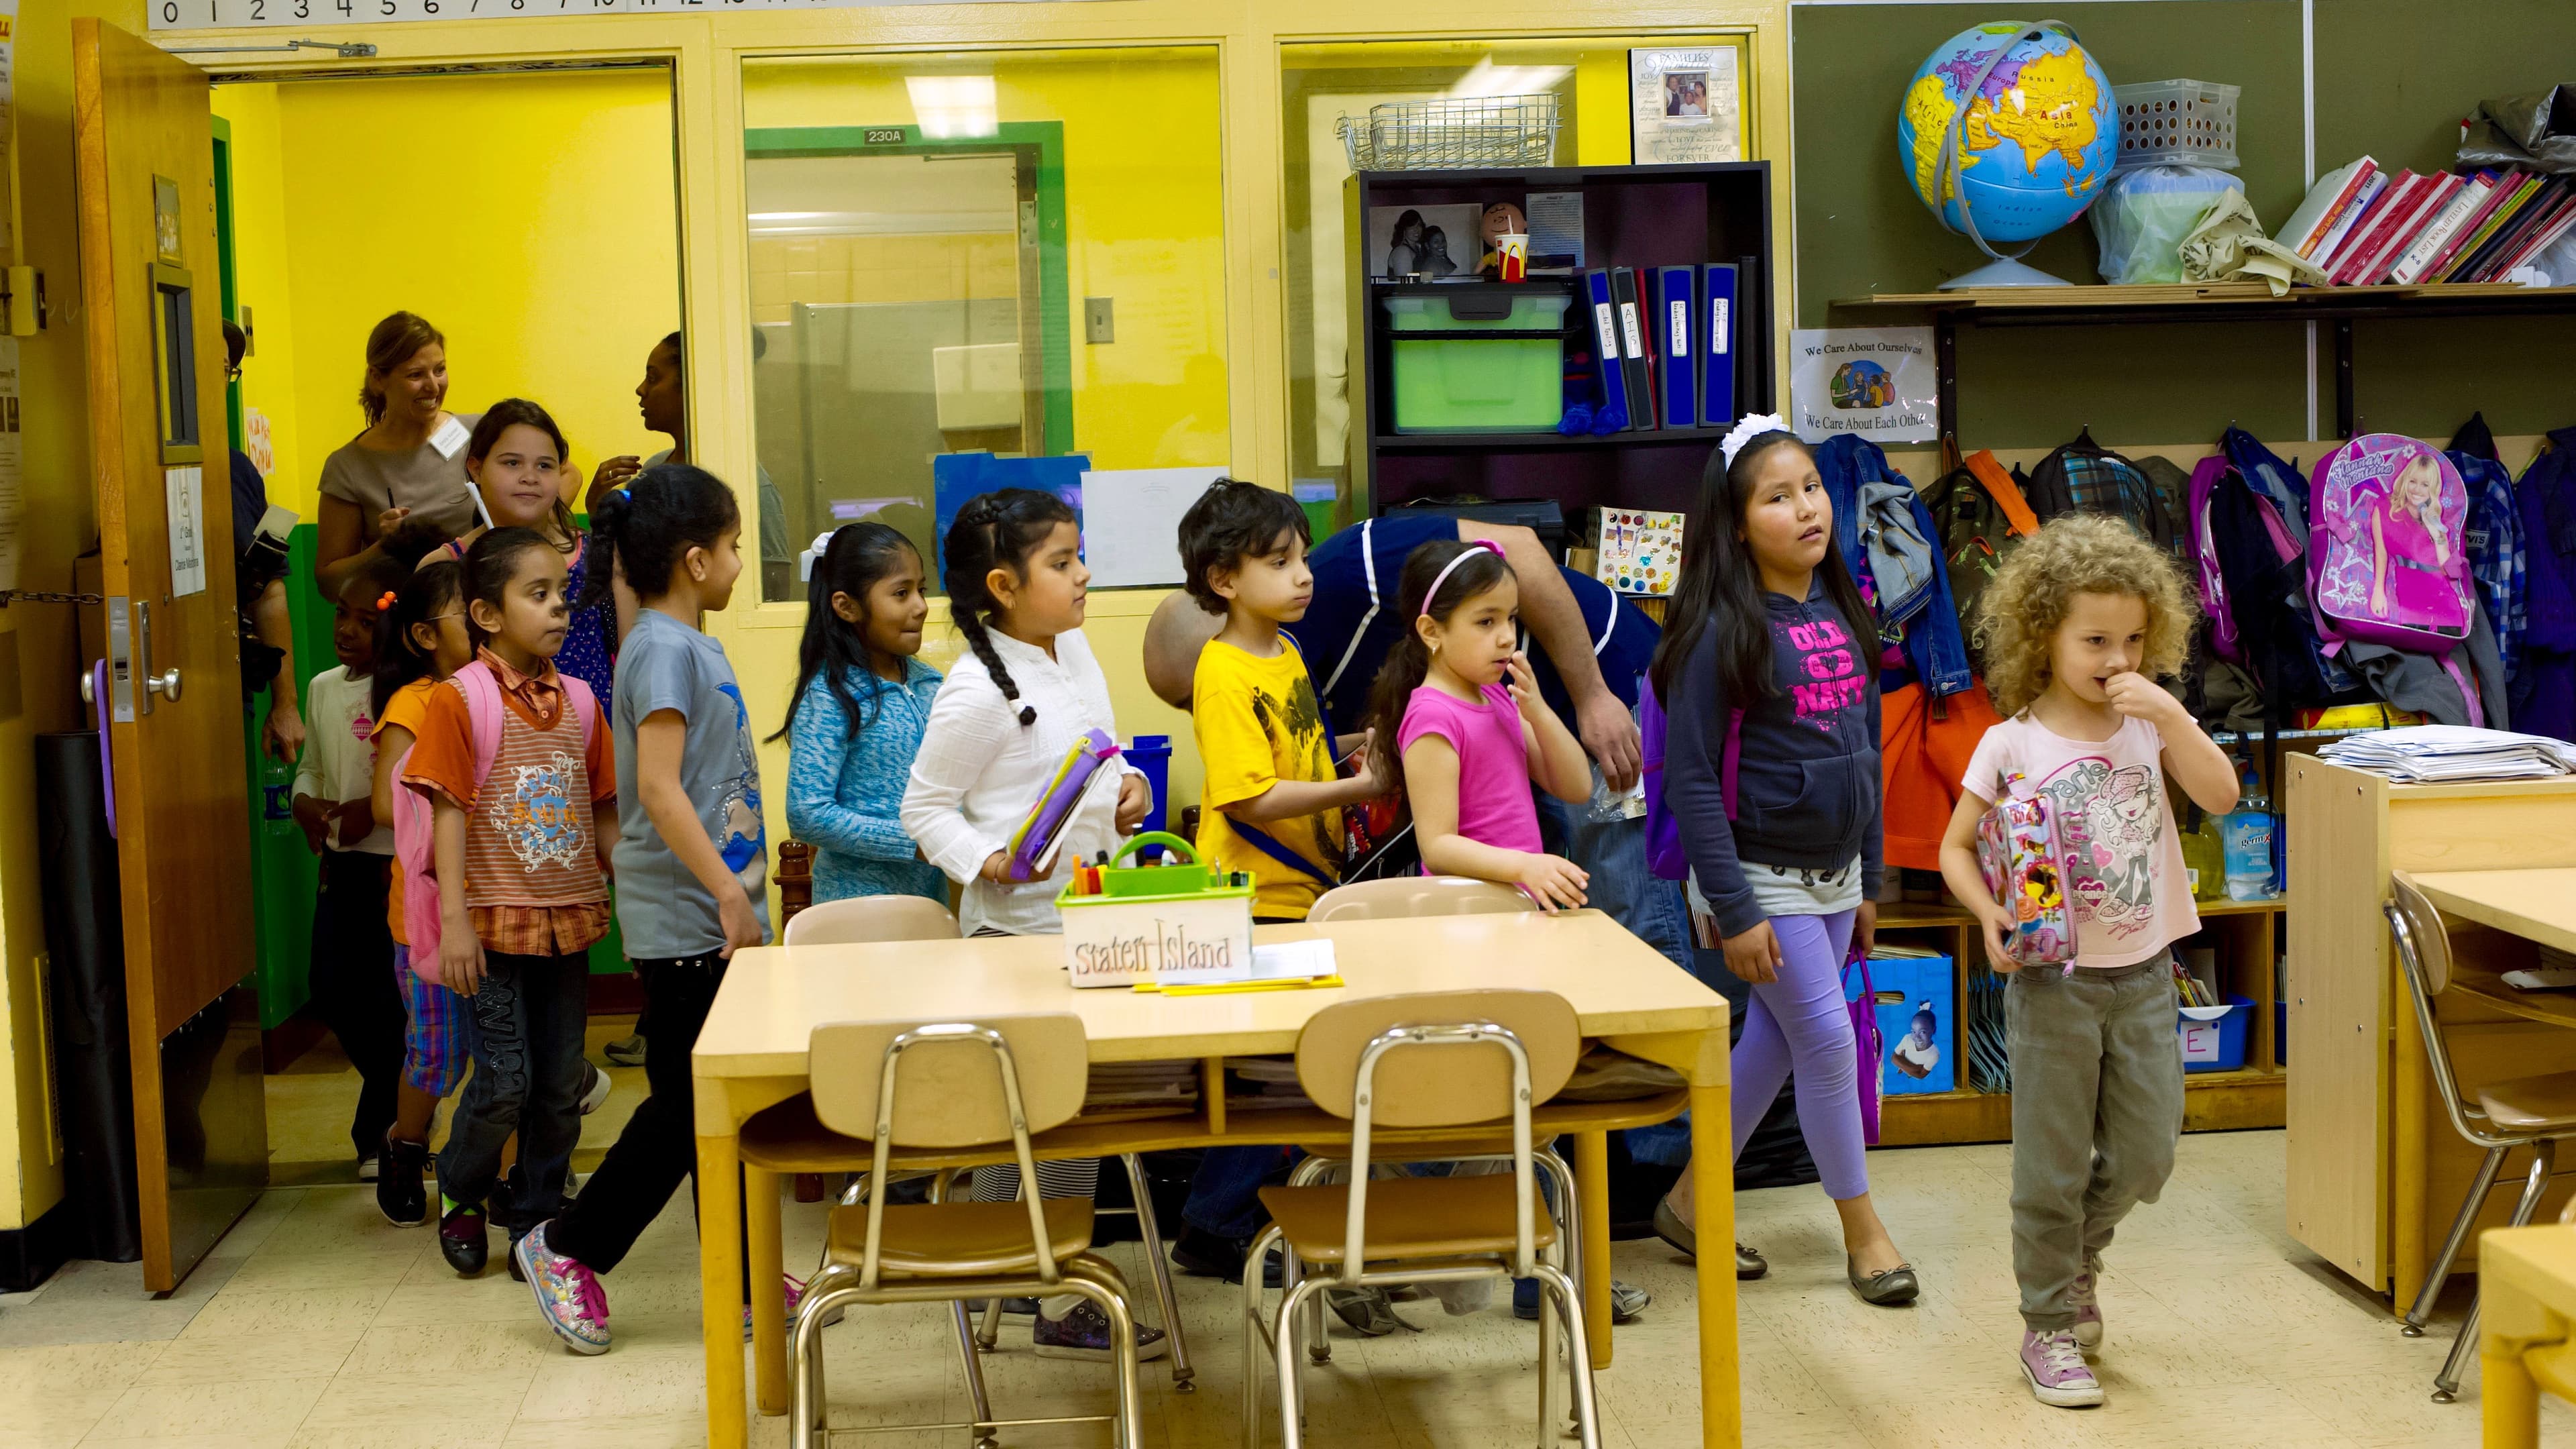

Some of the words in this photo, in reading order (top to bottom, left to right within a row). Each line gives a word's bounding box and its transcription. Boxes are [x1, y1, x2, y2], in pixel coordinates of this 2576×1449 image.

[163, 1, 178, 23] 0
[212, 0, 217, 21] 1
[250, 0, 266, 20] 2
[294, 0, 309, 18] 3
[337, 0, 353, 17] 4
[380, 0, 396, 15] 5
[424, 0, 440, 13] 6
[1987, 71, 2017, 87] Europe
[2011, 71, 2055, 83] Russia
[1917, 101, 1949, 131] Africa
[2040, 109, 2073, 121] Asia
[2054, 121, 2078, 129] China
[869, 131, 901, 142] 230A
[1666, 154, 1710, 163] FOREVER
[2365, 175, 2376, 189] 2011
[1998, 204, 2042, 212] Indian
[2443, 201, 2469, 227] LEVELED
[2431, 227, 2447, 242] BOOK
[2419, 240, 2434, 258] LIST
[1805, 346, 1821, 357] We
[1823, 344, 1845, 354] Care
[1846, 343, 1875, 352] About
[1878, 342, 1923, 355] Ourselves
[1805, 413, 1821, 429] We
[1823, 416, 1843, 429] Care
[1845, 417, 1873, 430] About
[1875, 415, 1897, 429] Each
[2334, 452, 2383, 480] Hannah
[2340, 464, 2394, 490] Montana
[1788, 621, 1847, 651] OLD
[1883, 637, 1901, 645] KITTY
[1792, 674, 1867, 716] NAVY
[1075, 936, 1148, 975] Staten
[1155, 918, 1233, 971] Island
[2187, 1028, 2206, 1054] E
